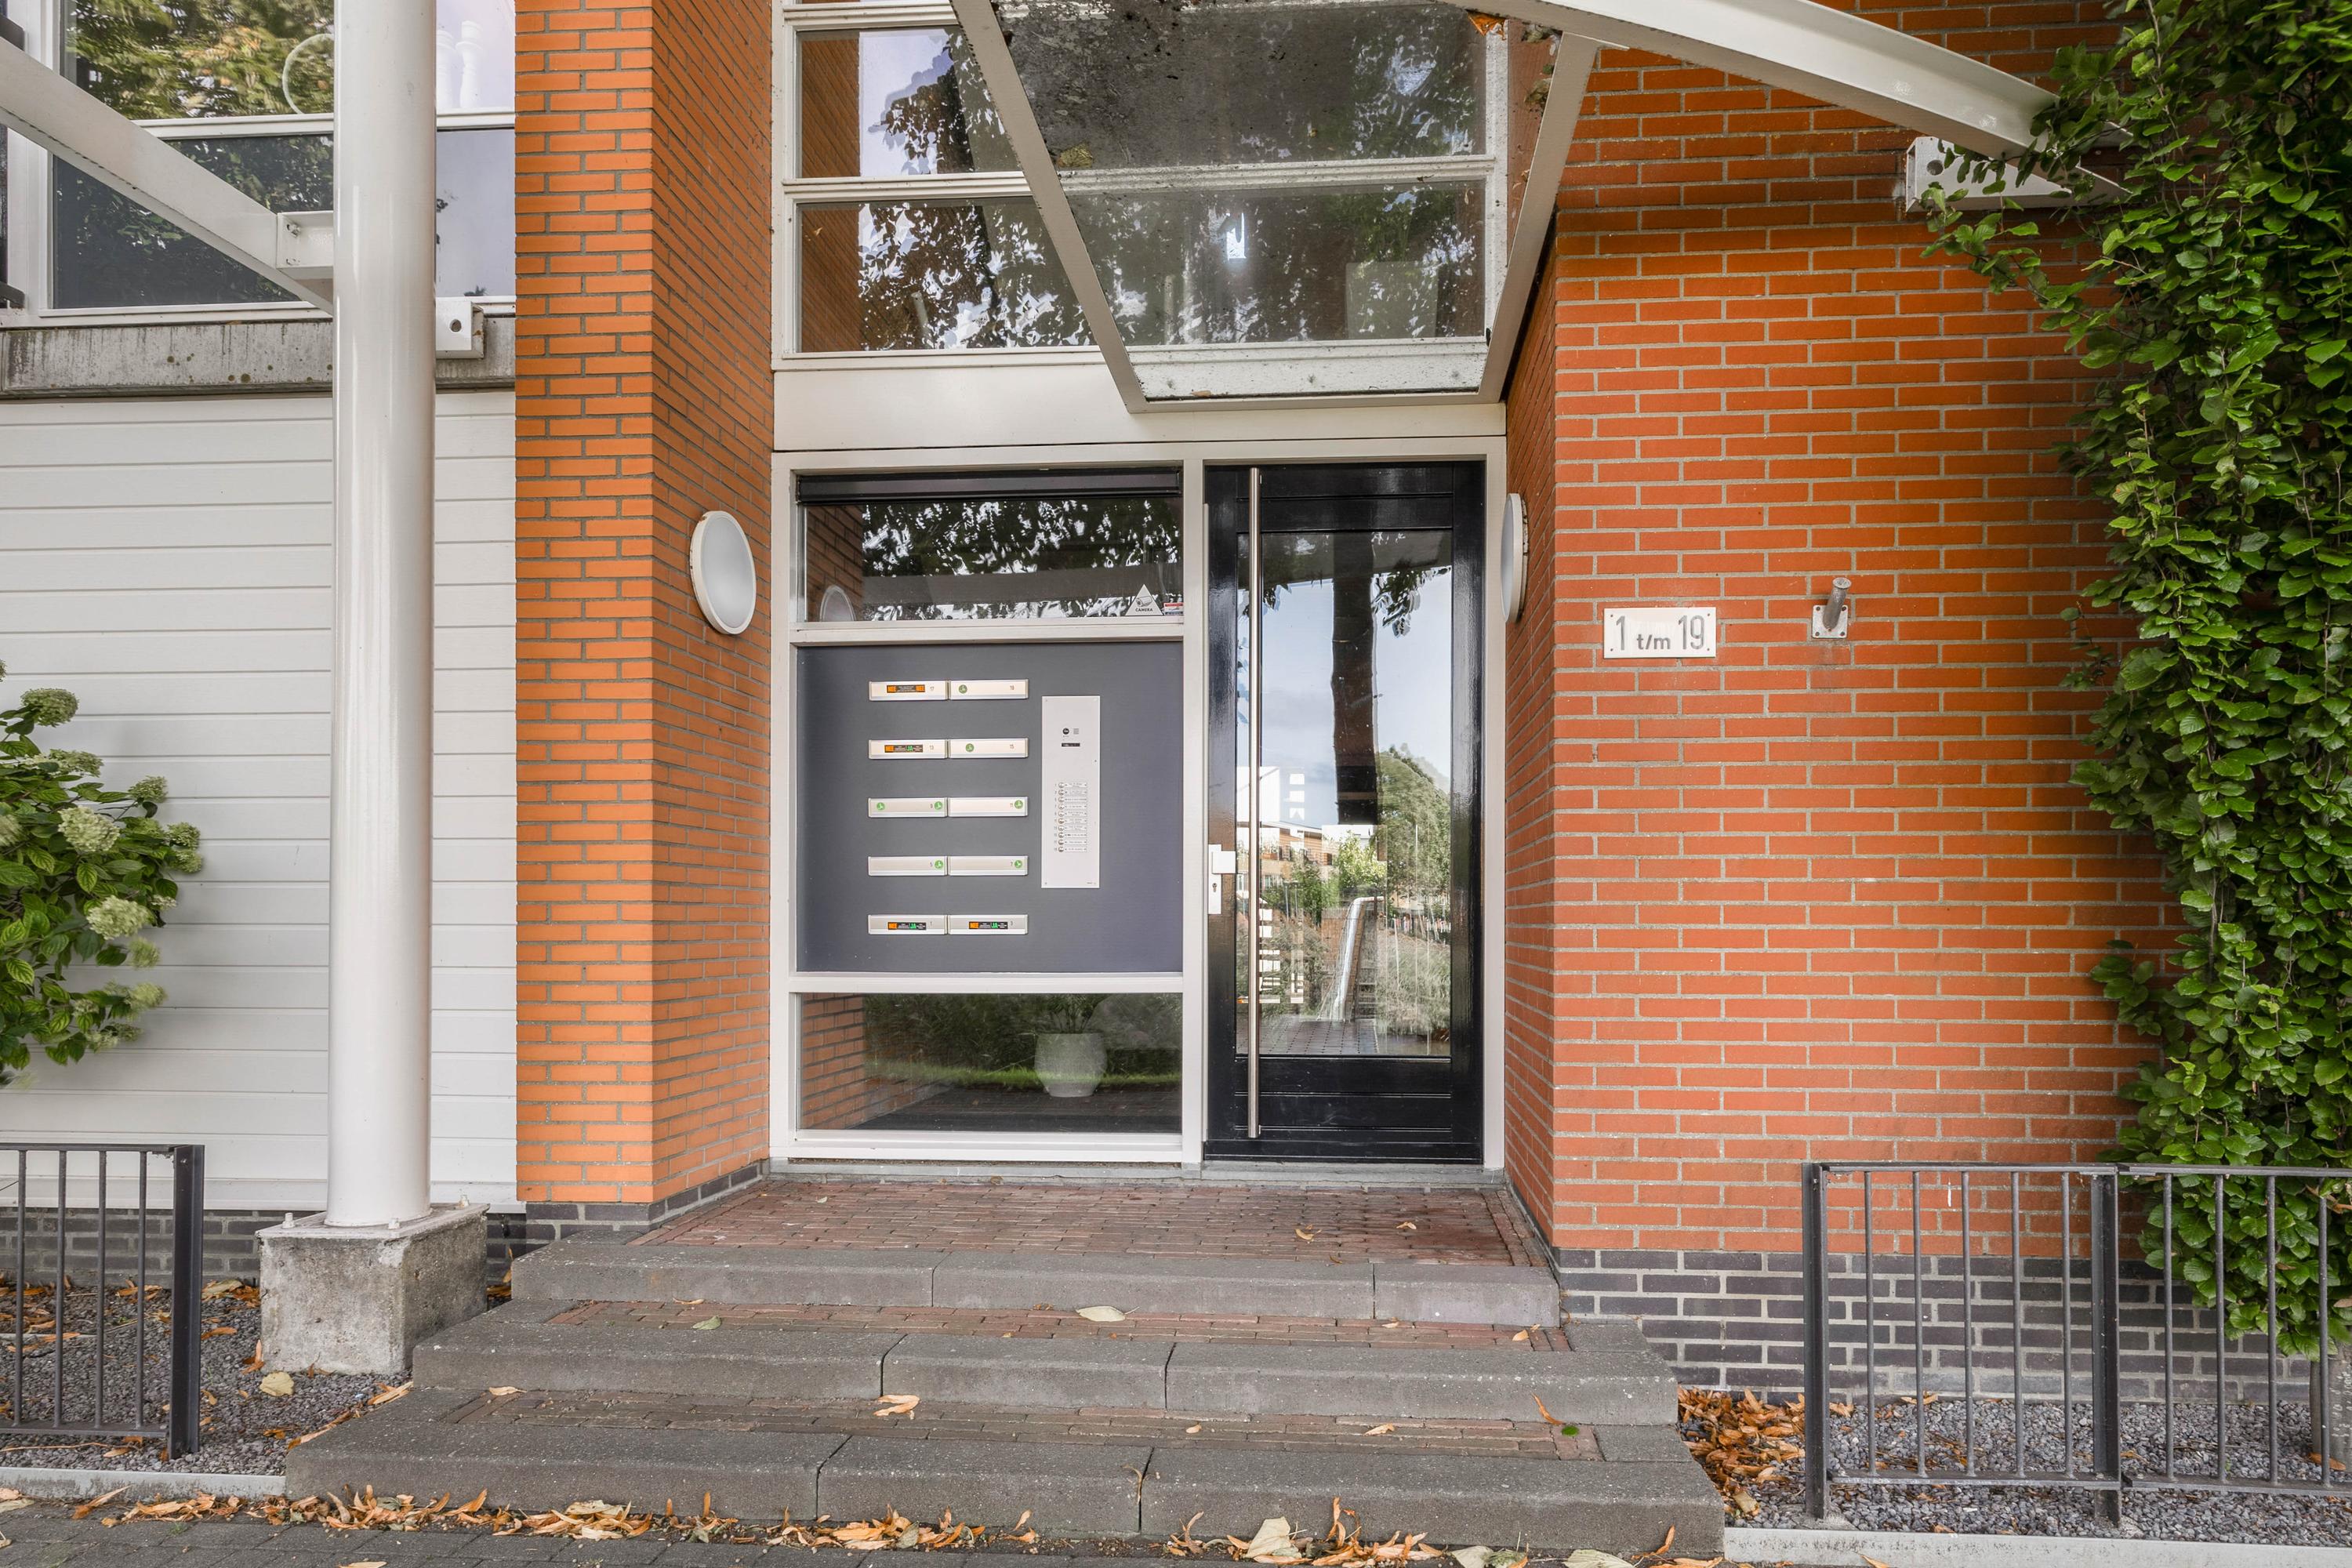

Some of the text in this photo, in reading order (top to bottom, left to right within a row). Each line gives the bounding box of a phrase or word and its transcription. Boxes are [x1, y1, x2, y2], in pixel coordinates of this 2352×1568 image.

[1616, 615, 1704, 651] 1 t/m 19
